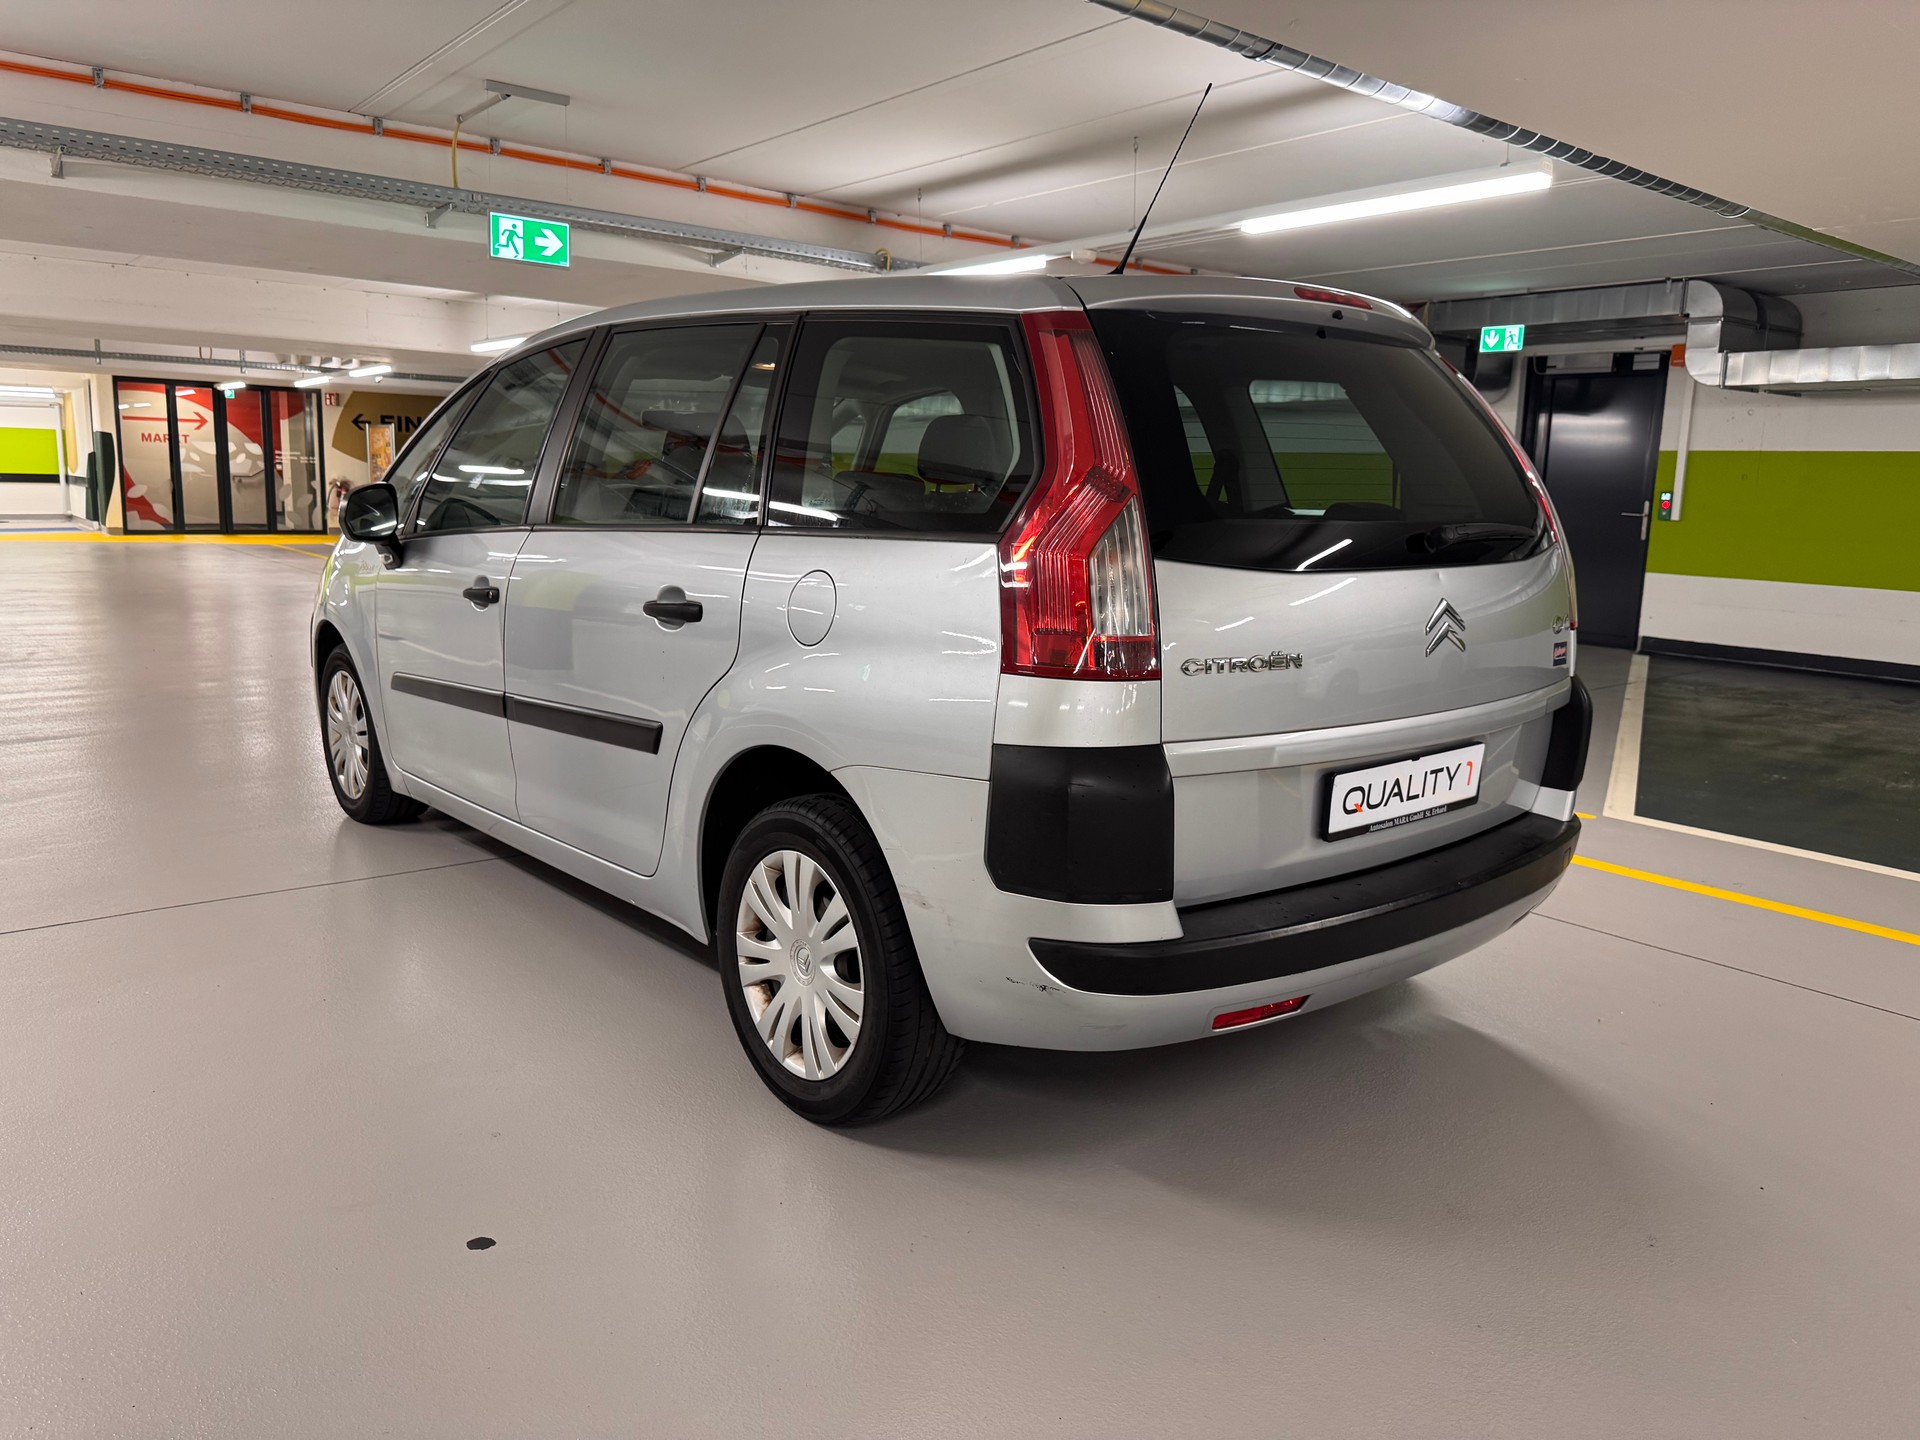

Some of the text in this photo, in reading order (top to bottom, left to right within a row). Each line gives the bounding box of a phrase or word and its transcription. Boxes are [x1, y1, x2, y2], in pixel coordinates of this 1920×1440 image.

[141, 432, 190, 444] MART
[1180, 650, 1303, 677] CITROËN
[1369, 820, 1393, 832] Autosalon
[1393, 816, 1409, 826] MARA
[1409, 811, 1424, 822] GmbH
[1432, 804, 1448, 816] Erhard
